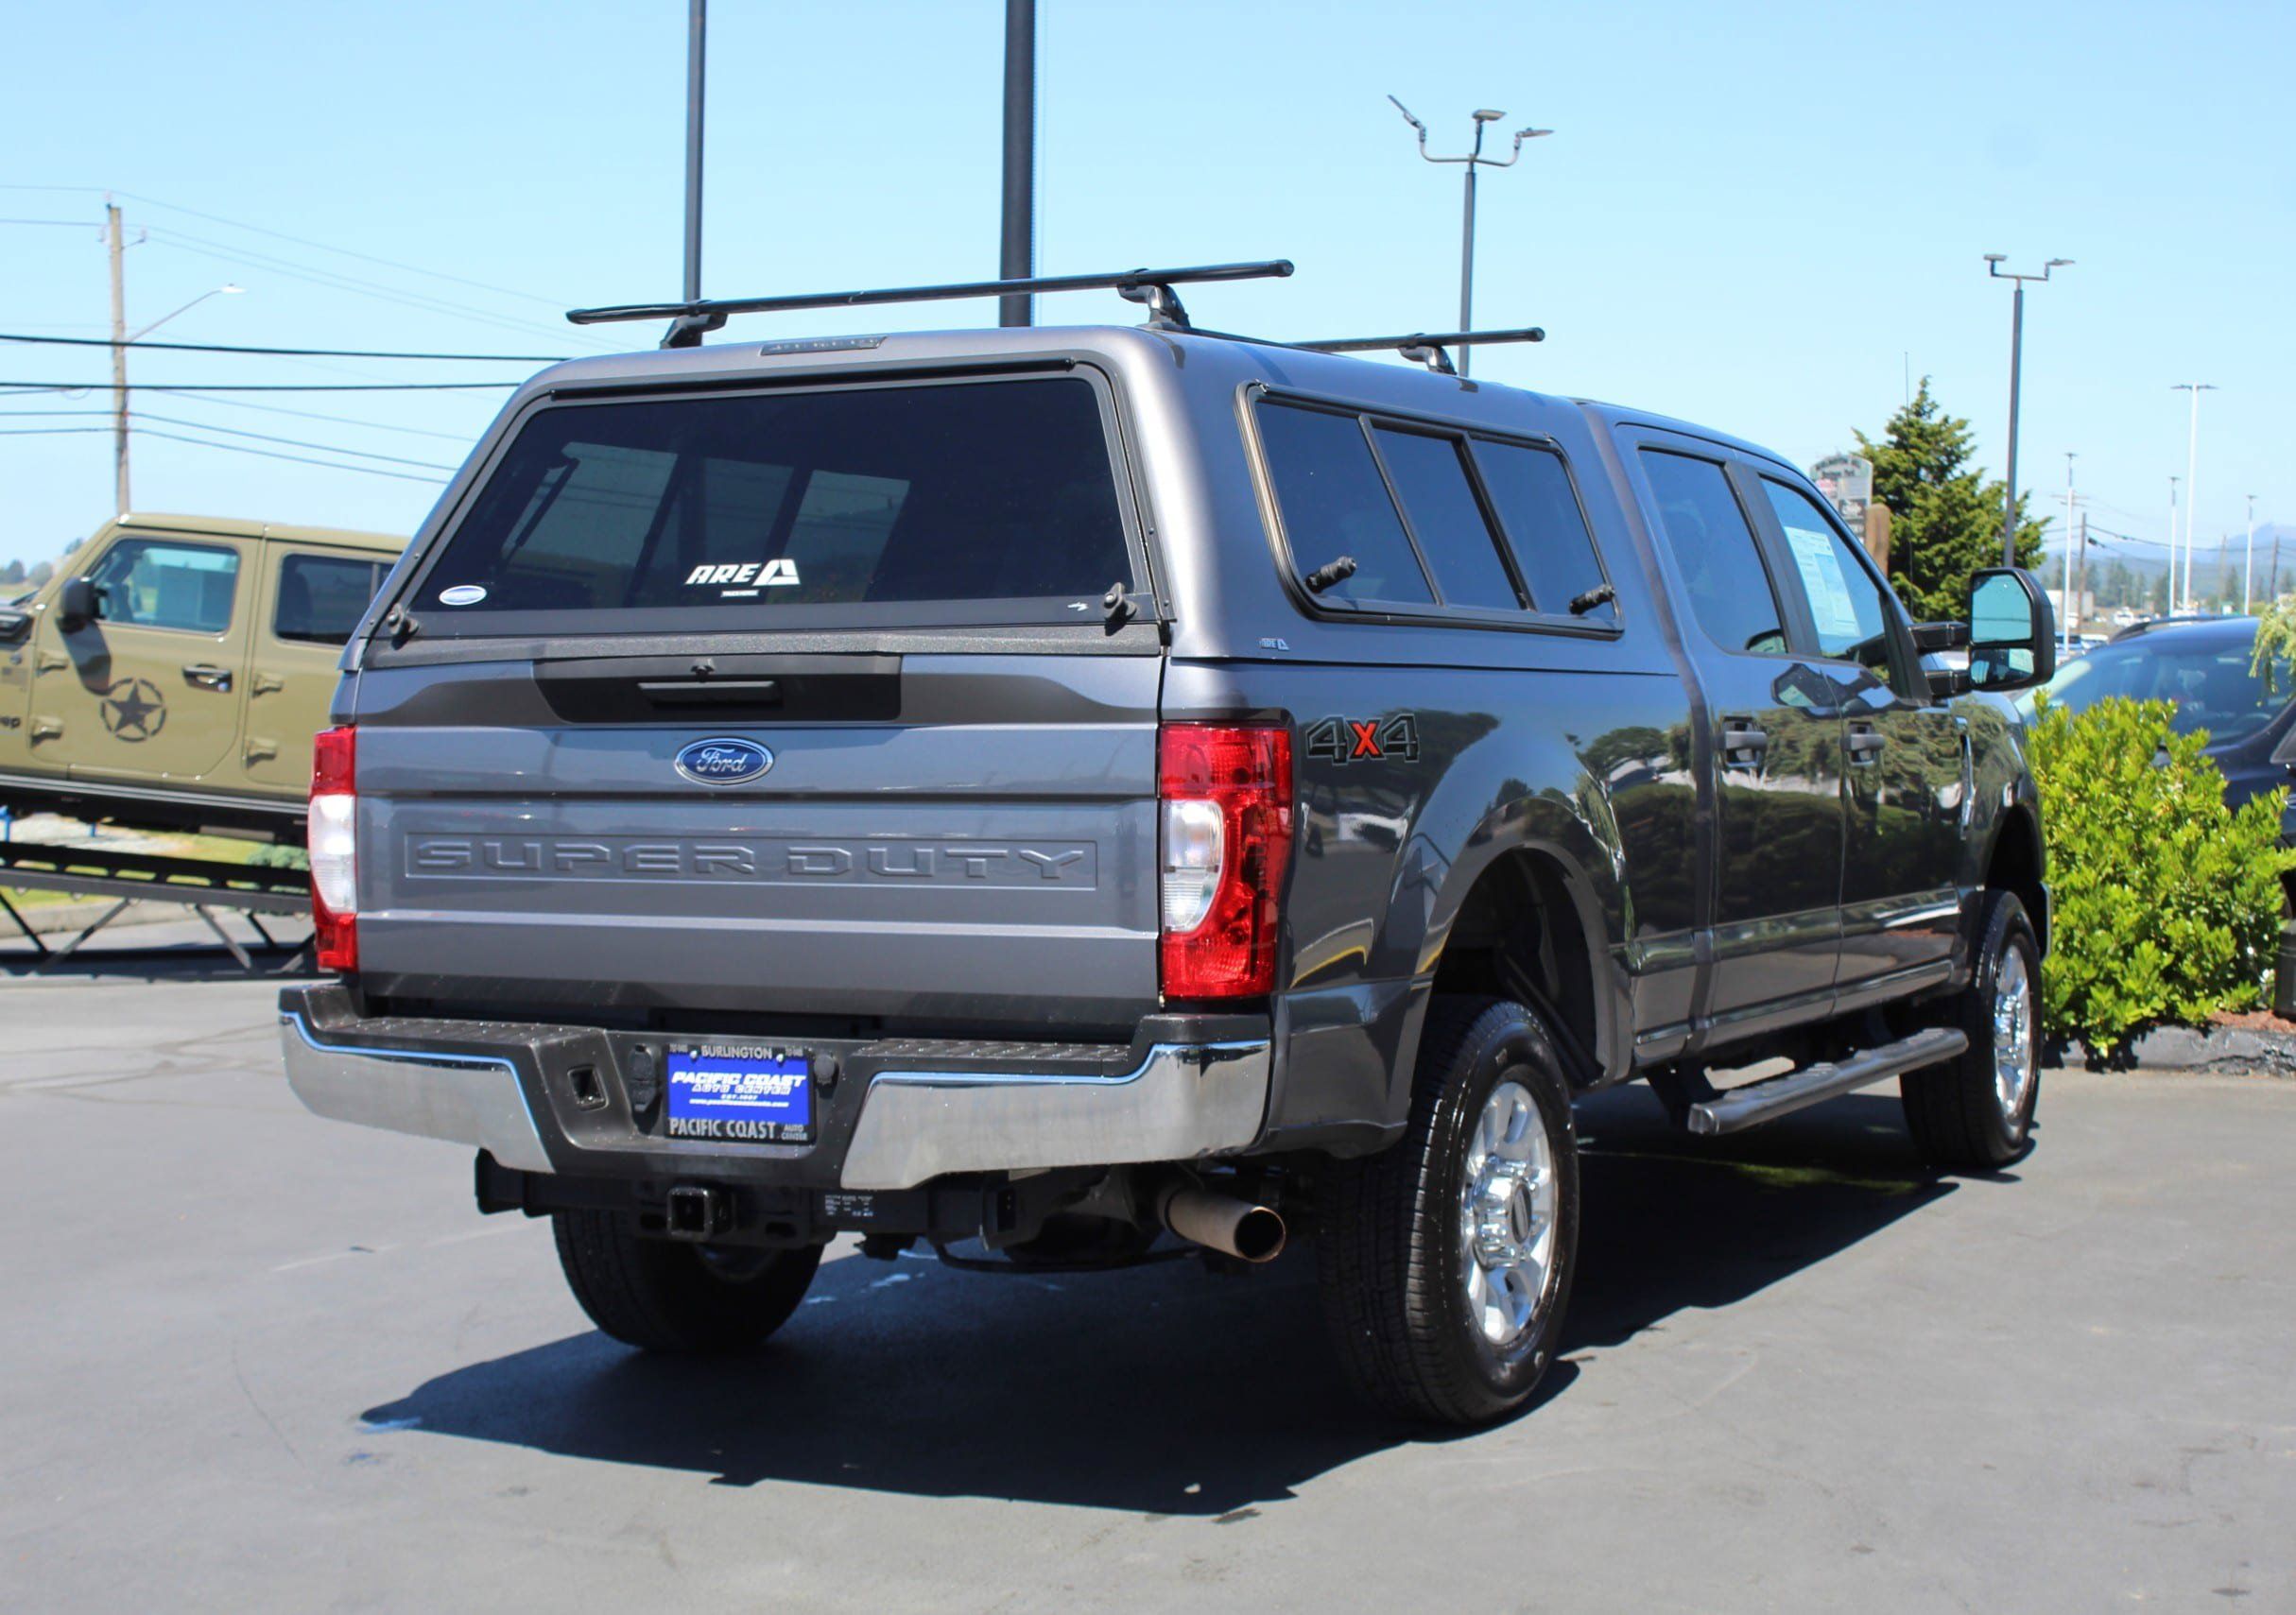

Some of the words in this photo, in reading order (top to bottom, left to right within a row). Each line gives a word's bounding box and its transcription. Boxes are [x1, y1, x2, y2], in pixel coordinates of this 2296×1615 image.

[696, 747, 749, 773] Ford
[417, 841, 755, 875] SUPER
[787, 847, 1084, 879] DUTY
[700, 1045, 773, 1060] BURLINGTON
[671, 1071, 743, 1086] PACIFIC
[743, 1073, 806, 1088] COAST
[668, 1117, 722, 1138] PACIFIC
[726, 1119, 777, 1140] COAST
